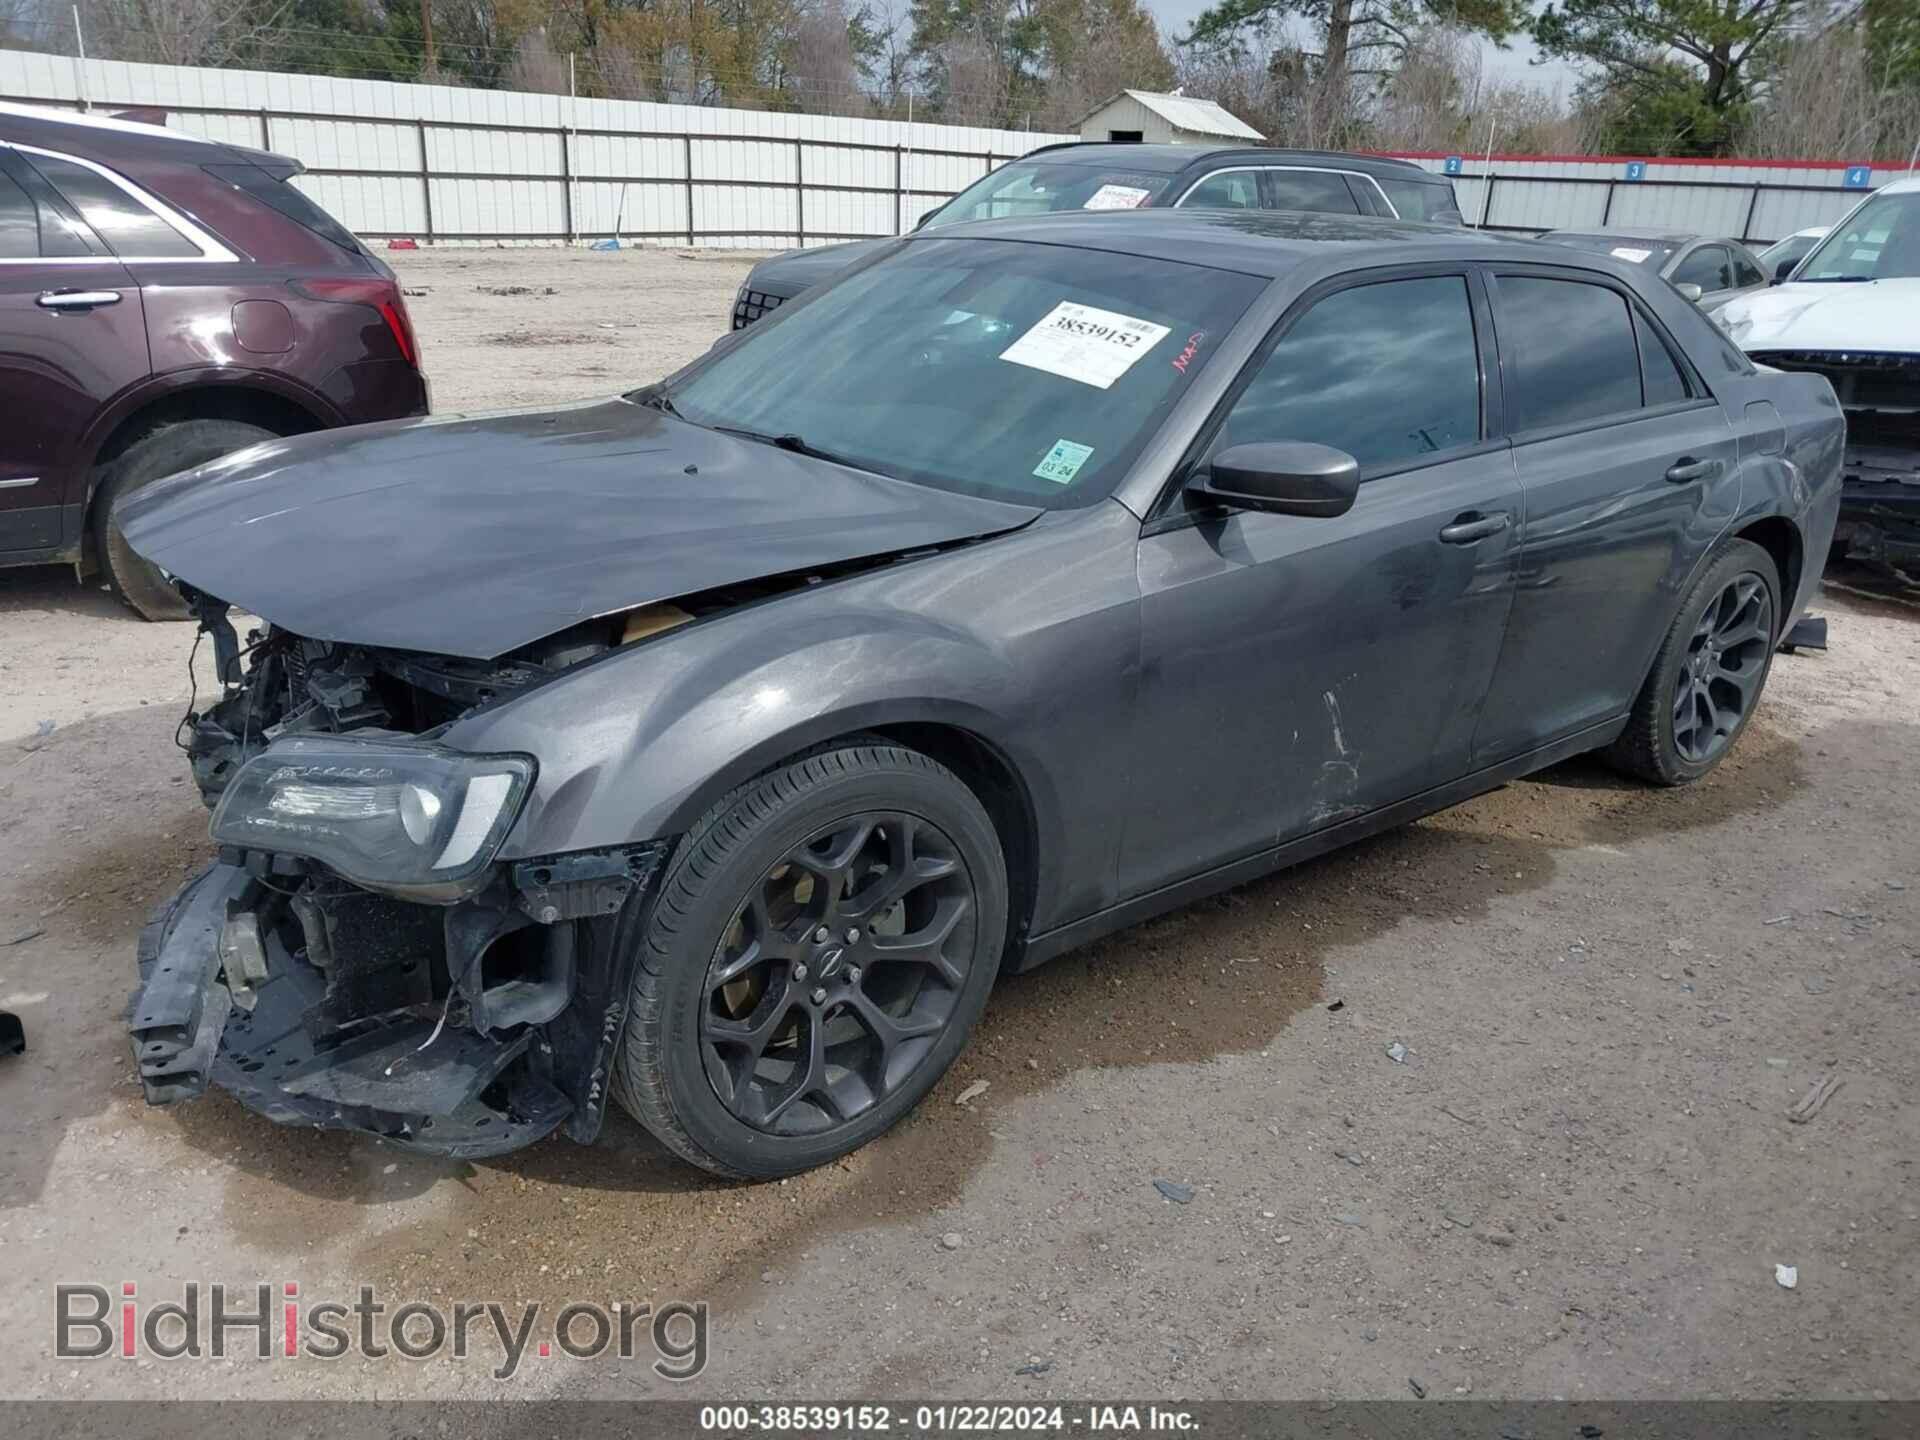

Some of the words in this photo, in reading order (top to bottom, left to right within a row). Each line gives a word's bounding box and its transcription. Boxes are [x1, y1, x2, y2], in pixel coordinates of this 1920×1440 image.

[1449, 160, 1457, 171] 2
[1631, 165, 1640, 177] 3
[1852, 170, 1861, 183] 4
[1049, 316, 1141, 348] 38539152
[1057, 465, 1073, 476] 24
